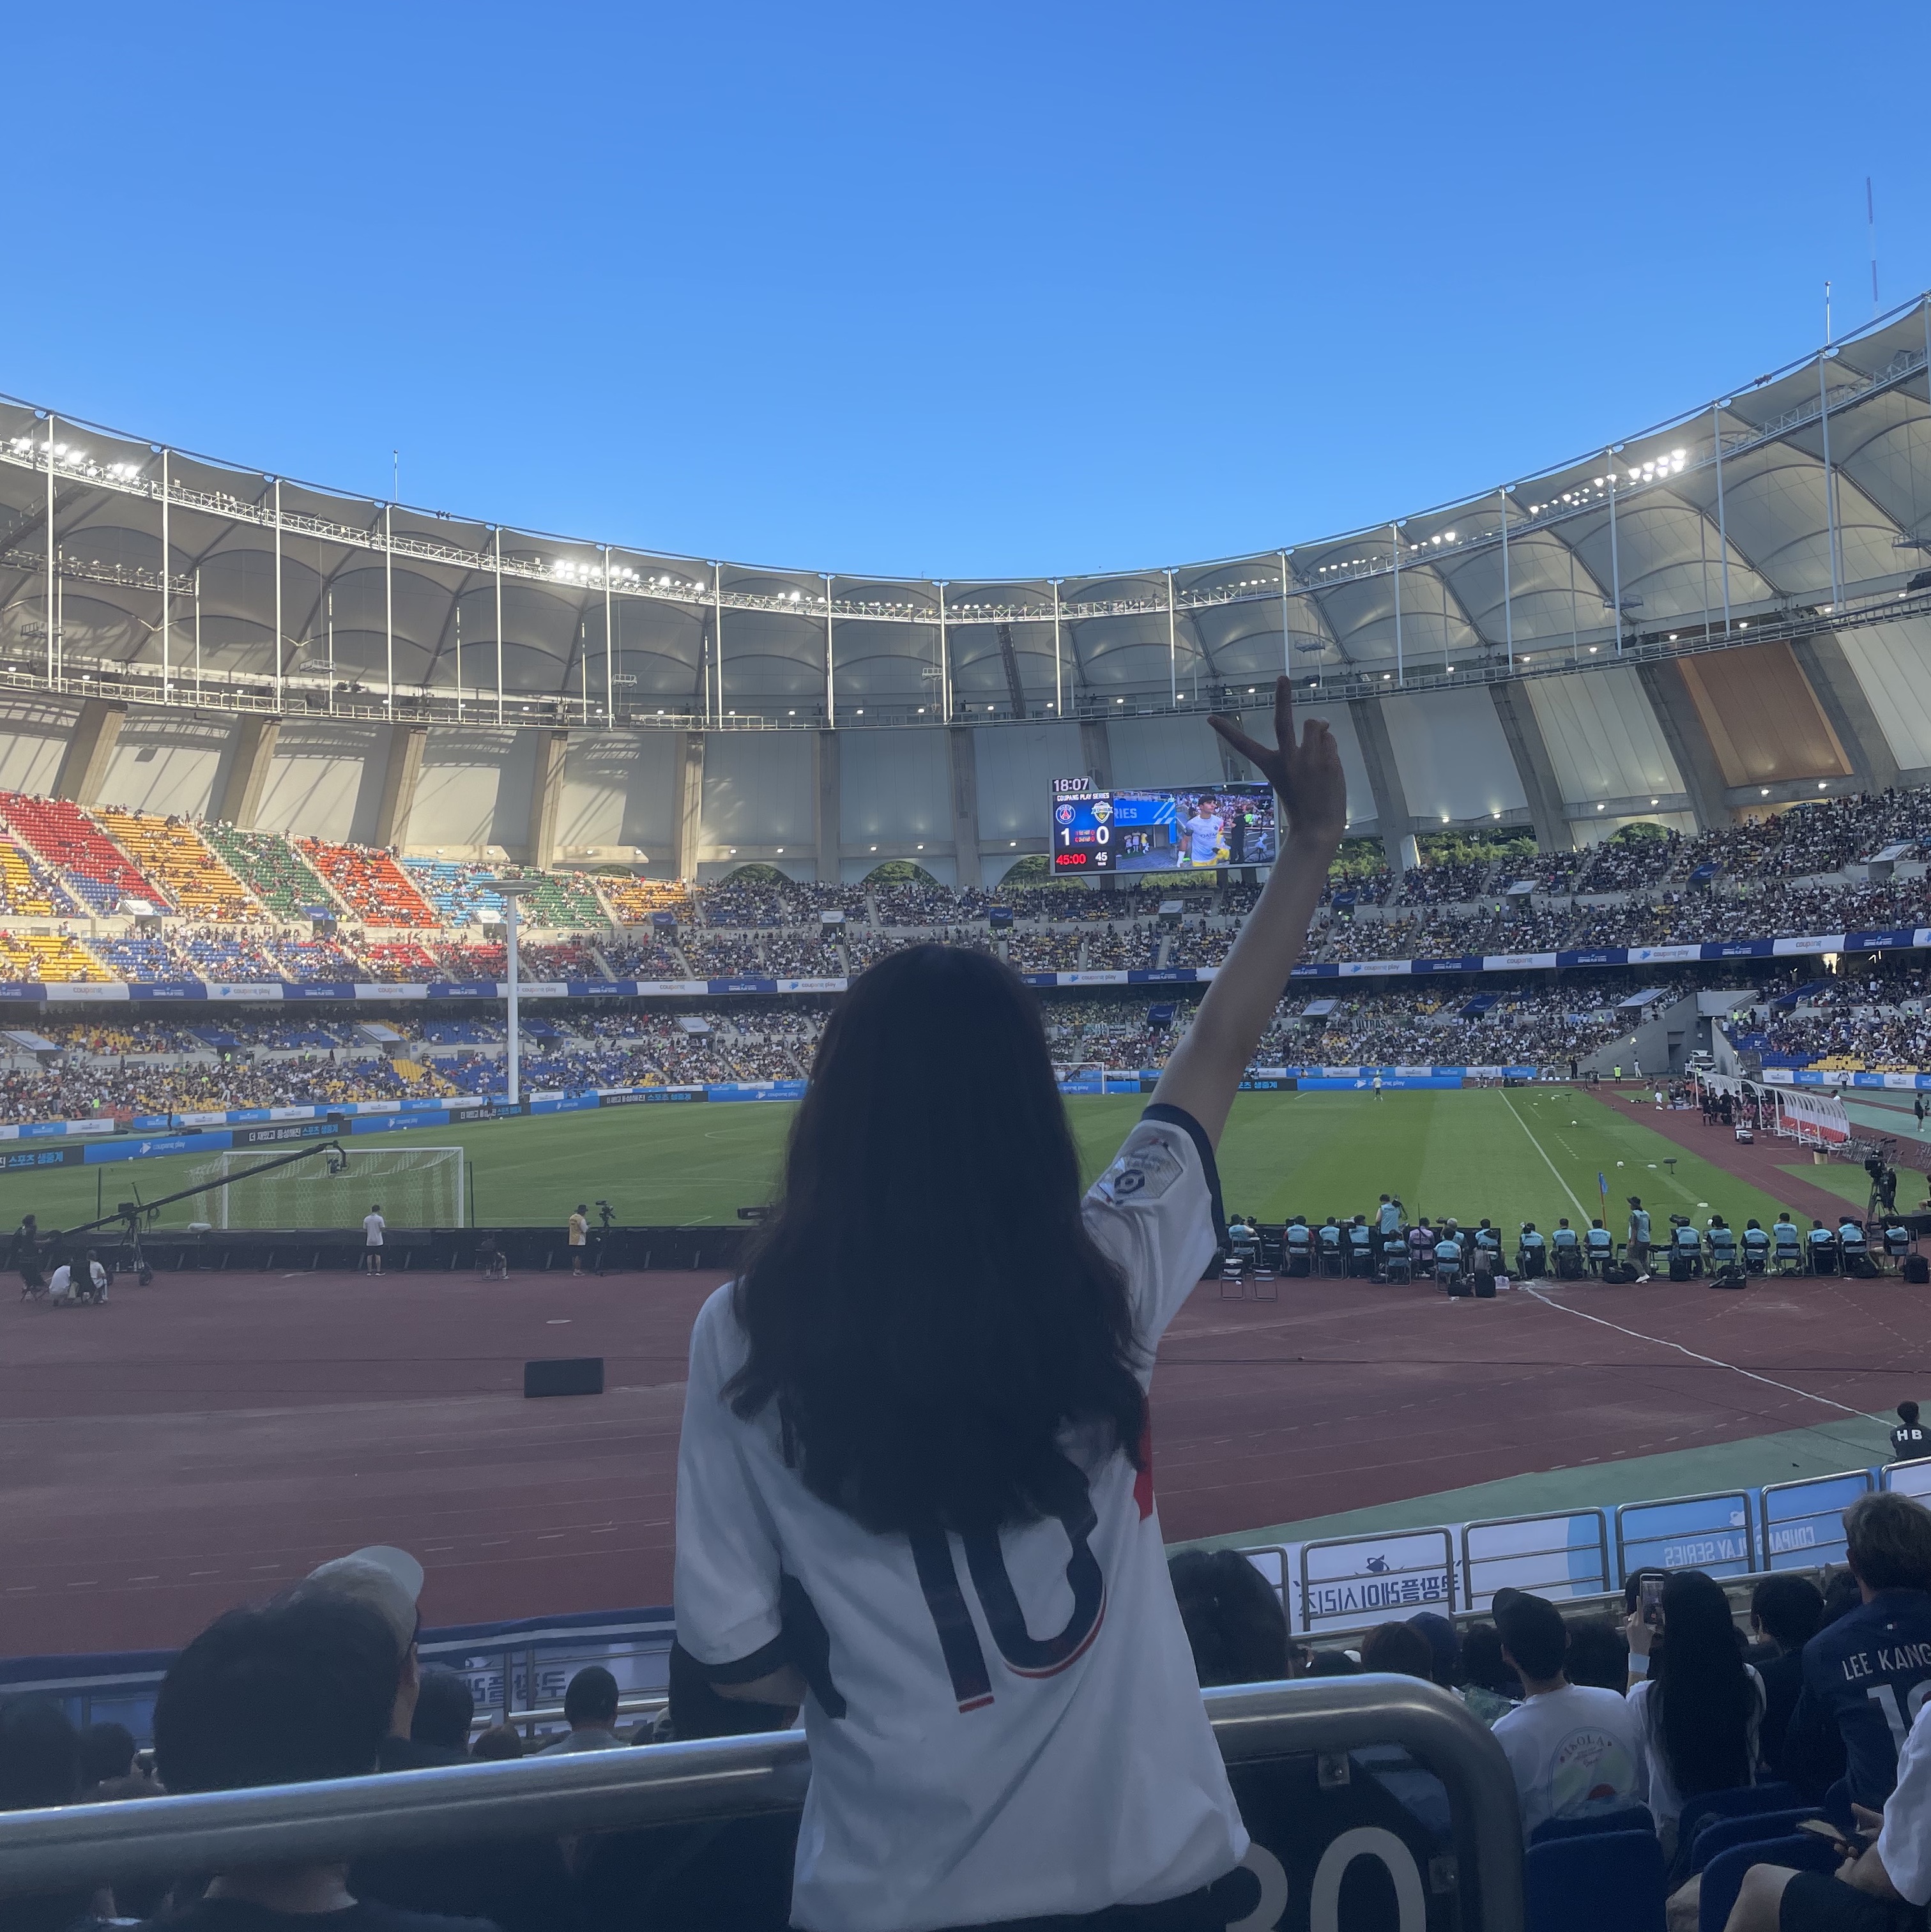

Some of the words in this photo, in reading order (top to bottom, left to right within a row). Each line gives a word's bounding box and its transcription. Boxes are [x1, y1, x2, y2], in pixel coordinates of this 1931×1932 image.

[1054, 778, 1088, 791] 18:07
[1061, 828, 1070, 846] 1
[1097, 826, 1110, 844] 0
[1056, 853, 1087, 865] 45:00
[1095, 852, 1108, 861] 45
[249, 1132, 256, 1141] 더
[302, 1126, 319, 1136] 스포츠
[8, 1154, 34, 1167] 스포츠
[38, 1151, 63, 1164] 생중계
[1842, 1652, 1873, 1680] LEE
[1877, 1643, 1931, 1670] KANG
